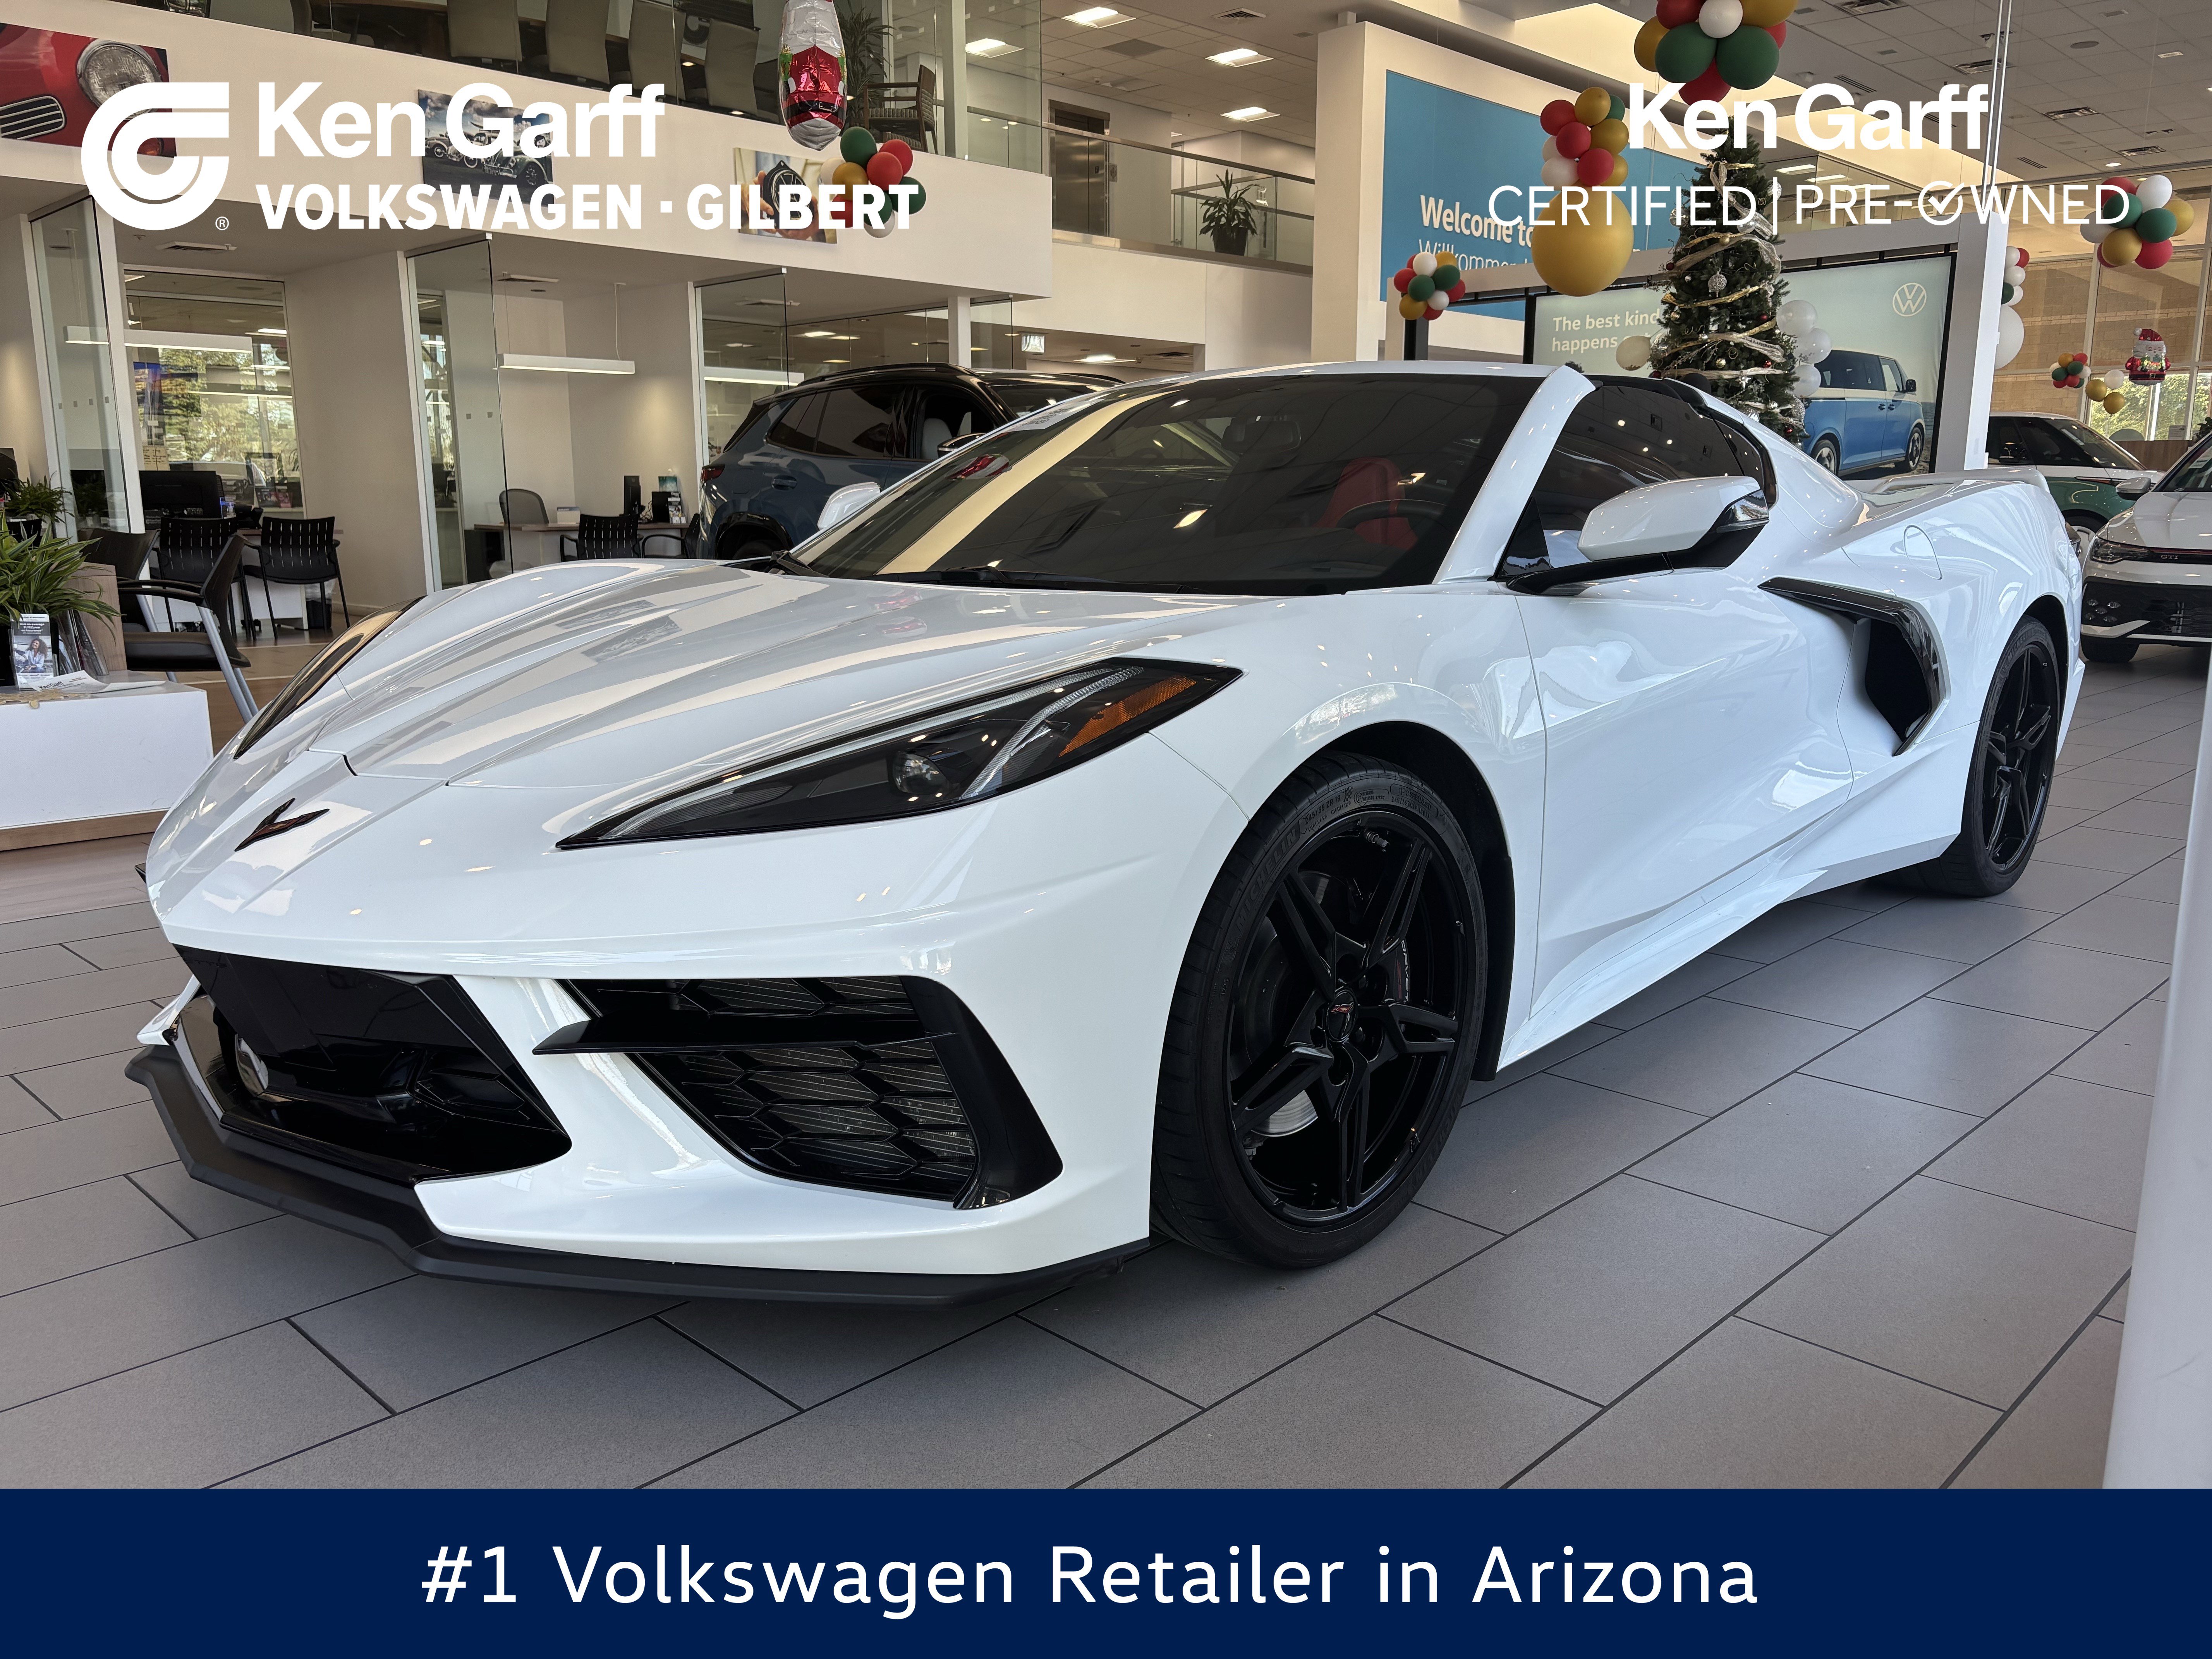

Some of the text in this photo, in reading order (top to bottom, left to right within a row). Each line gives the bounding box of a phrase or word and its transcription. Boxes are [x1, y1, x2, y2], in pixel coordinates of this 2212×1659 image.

[1420, 195, 1513, 243] Welcome
[1553, 308, 1660, 331] The best kind
[1552, 337, 1618, 354] happens
[1235, 828, 1298, 932] MICHELIN
